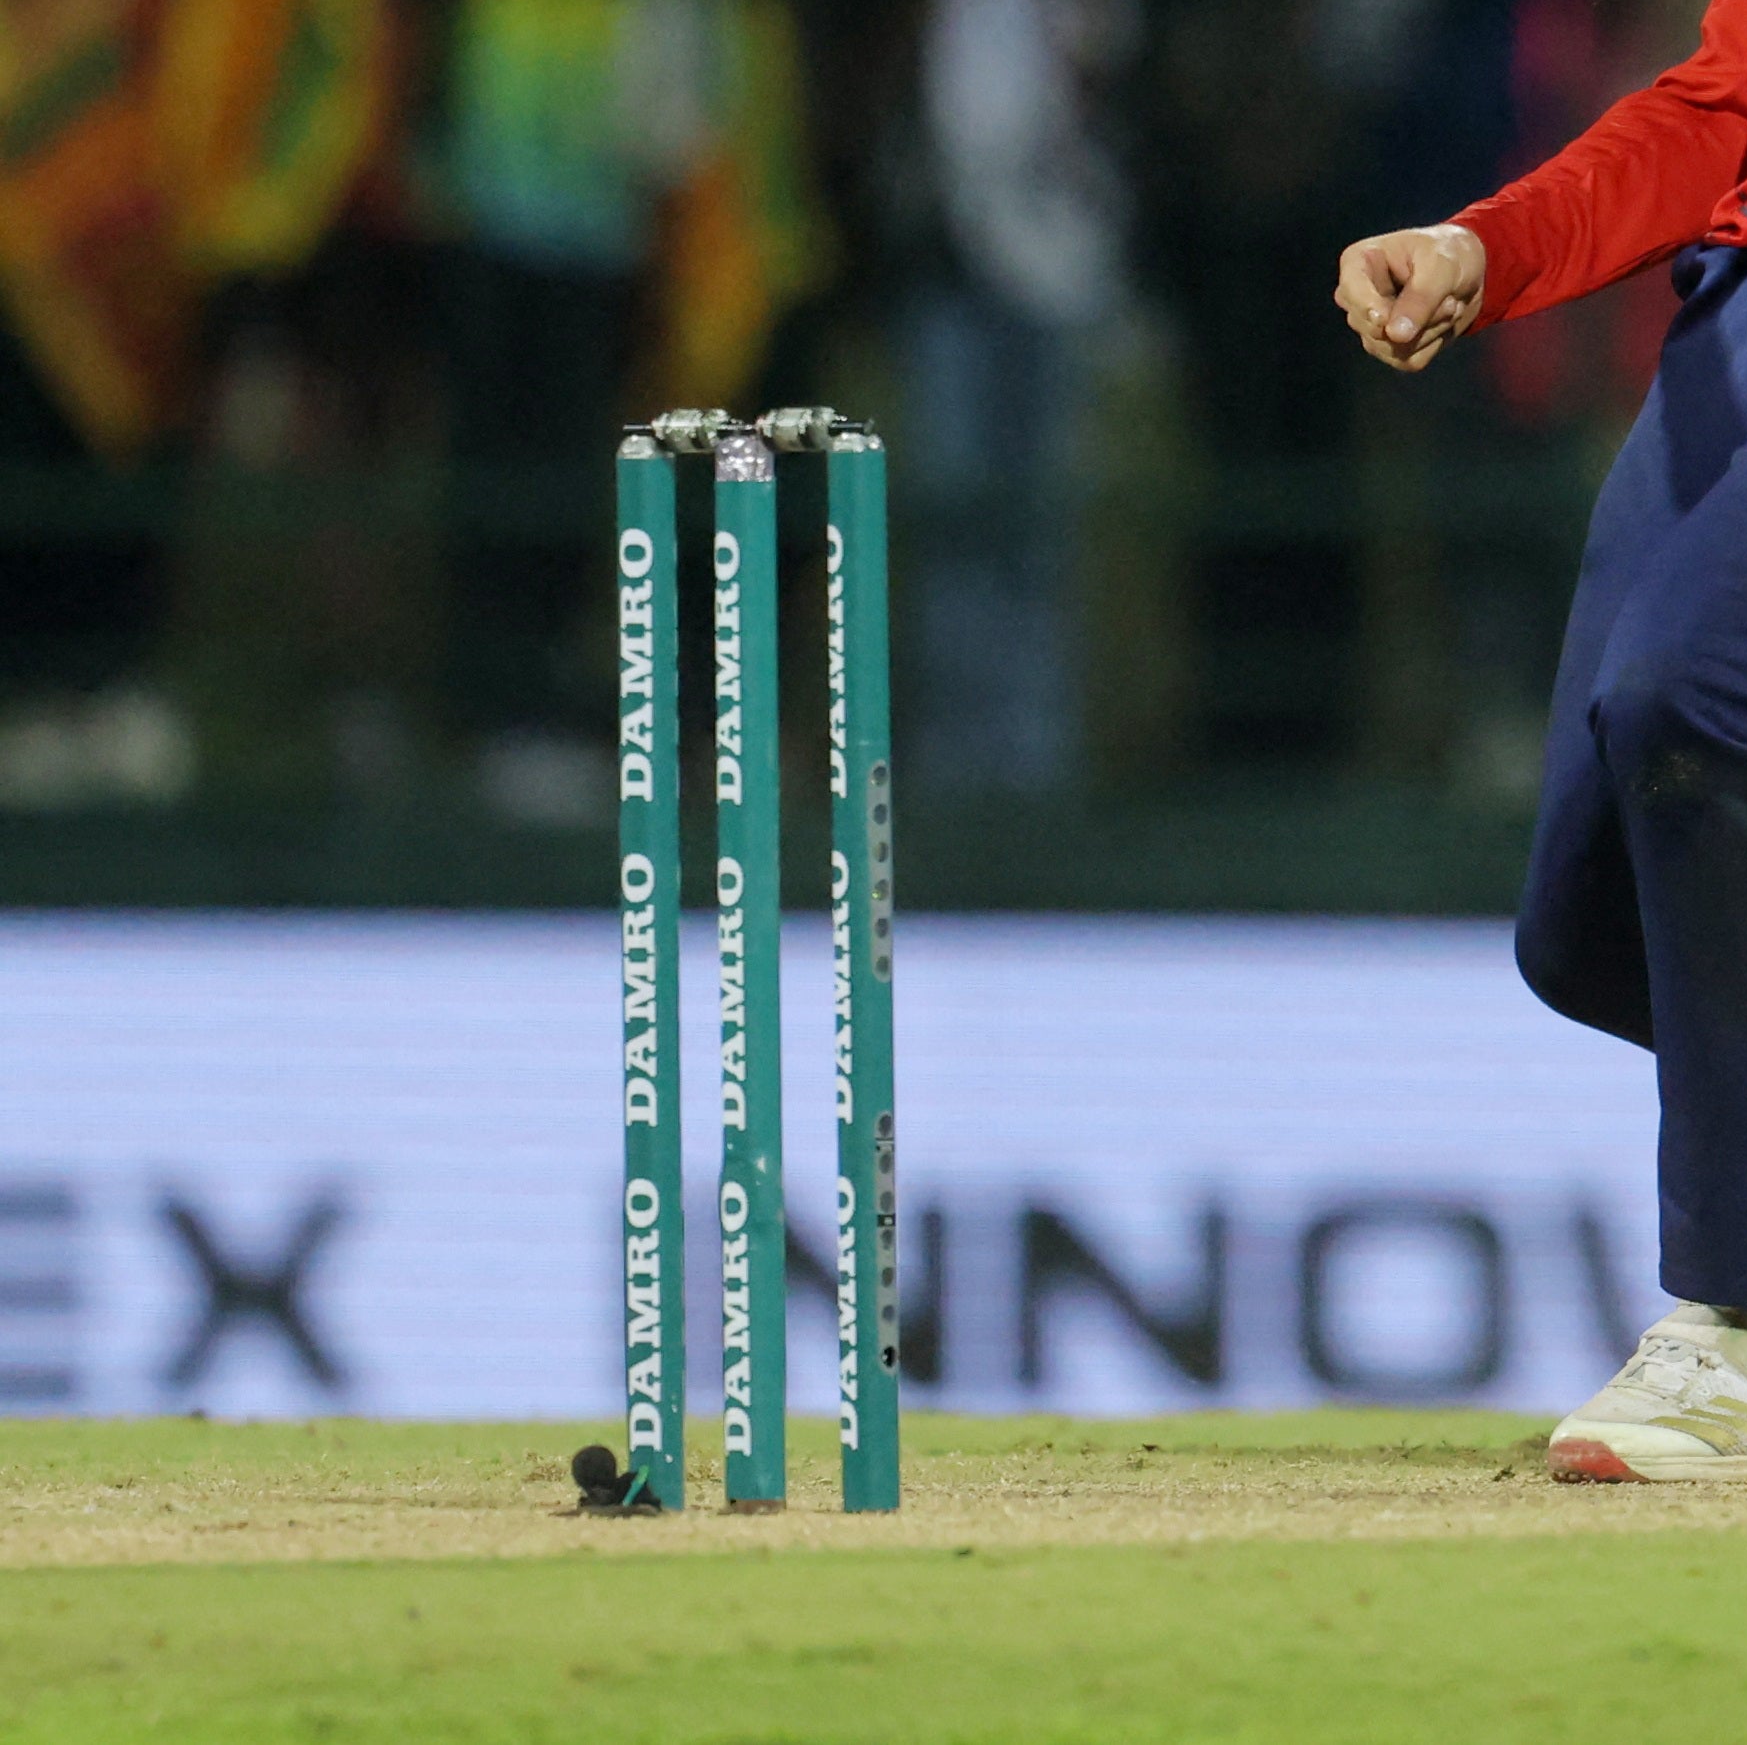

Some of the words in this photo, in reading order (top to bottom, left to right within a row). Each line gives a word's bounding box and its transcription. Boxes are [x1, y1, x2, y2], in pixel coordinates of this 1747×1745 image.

[619, 528, 654, 802] DAMRO
[714, 531, 742, 806] DAMRO
[621, 853, 658, 1127] DAMRO
[717, 856, 746, 1131] DAMRO
[625, 1178, 662, 1452] DAMRO
[720, 1181, 751, 1457] DAMRO
